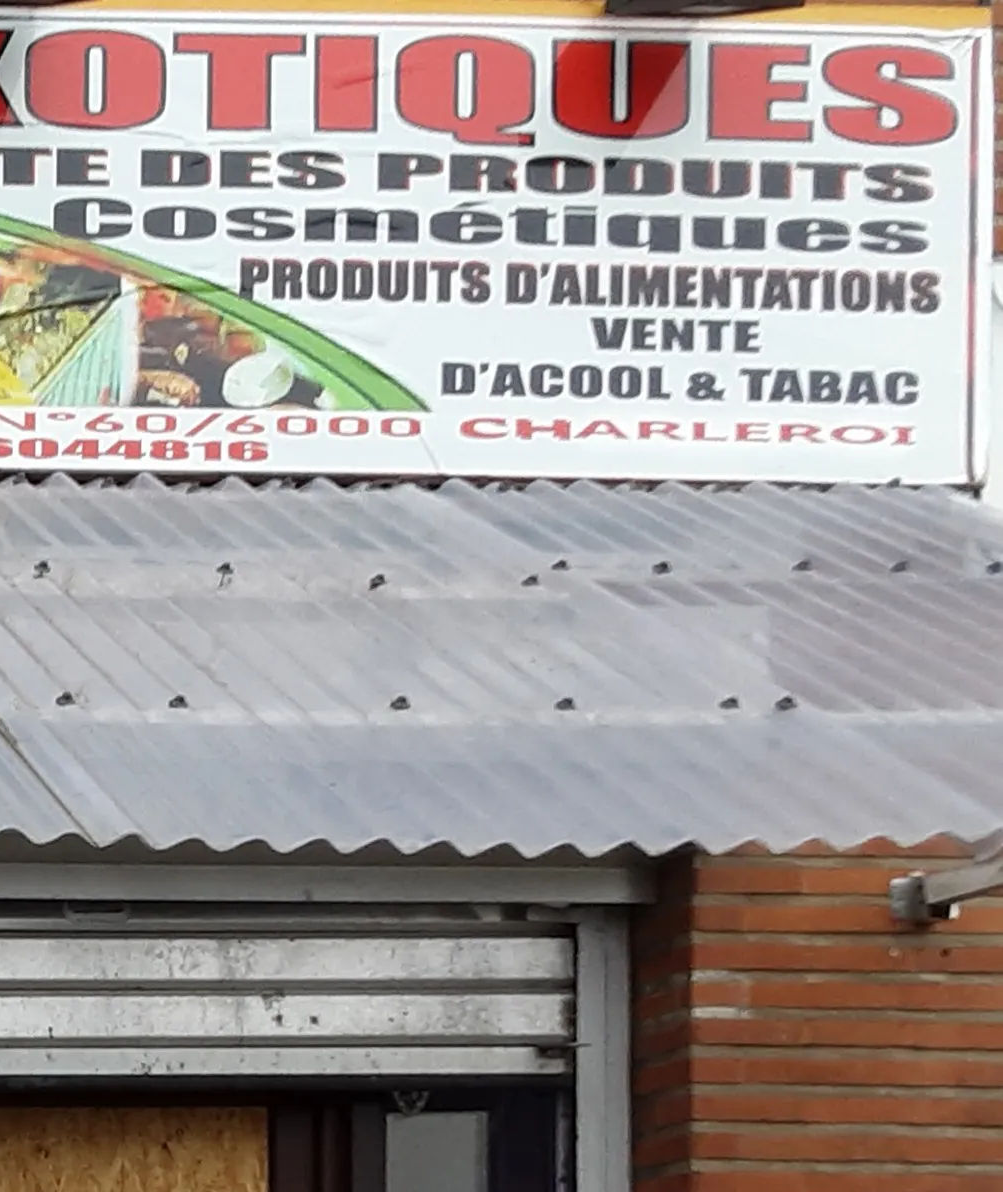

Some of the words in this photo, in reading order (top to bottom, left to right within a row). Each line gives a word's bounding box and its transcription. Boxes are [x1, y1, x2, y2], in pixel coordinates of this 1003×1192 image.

[140, 150, 347, 190] DES
[377, 152, 936, 203] PRODUITS
[52, 197, 930, 254] Cosmétiques
[239, 258, 492, 304] PRODUITS
[505, 262, 942, 313] D'ALIMENTATIONS
[591, 317, 762, 353] VENTE
[441, 362, 672, 400] D'ACOOL
[685, 371, 726, 402] &
[739, 368, 921, 405] TABAC
[459, 417, 917, 446] CHARLEROI
